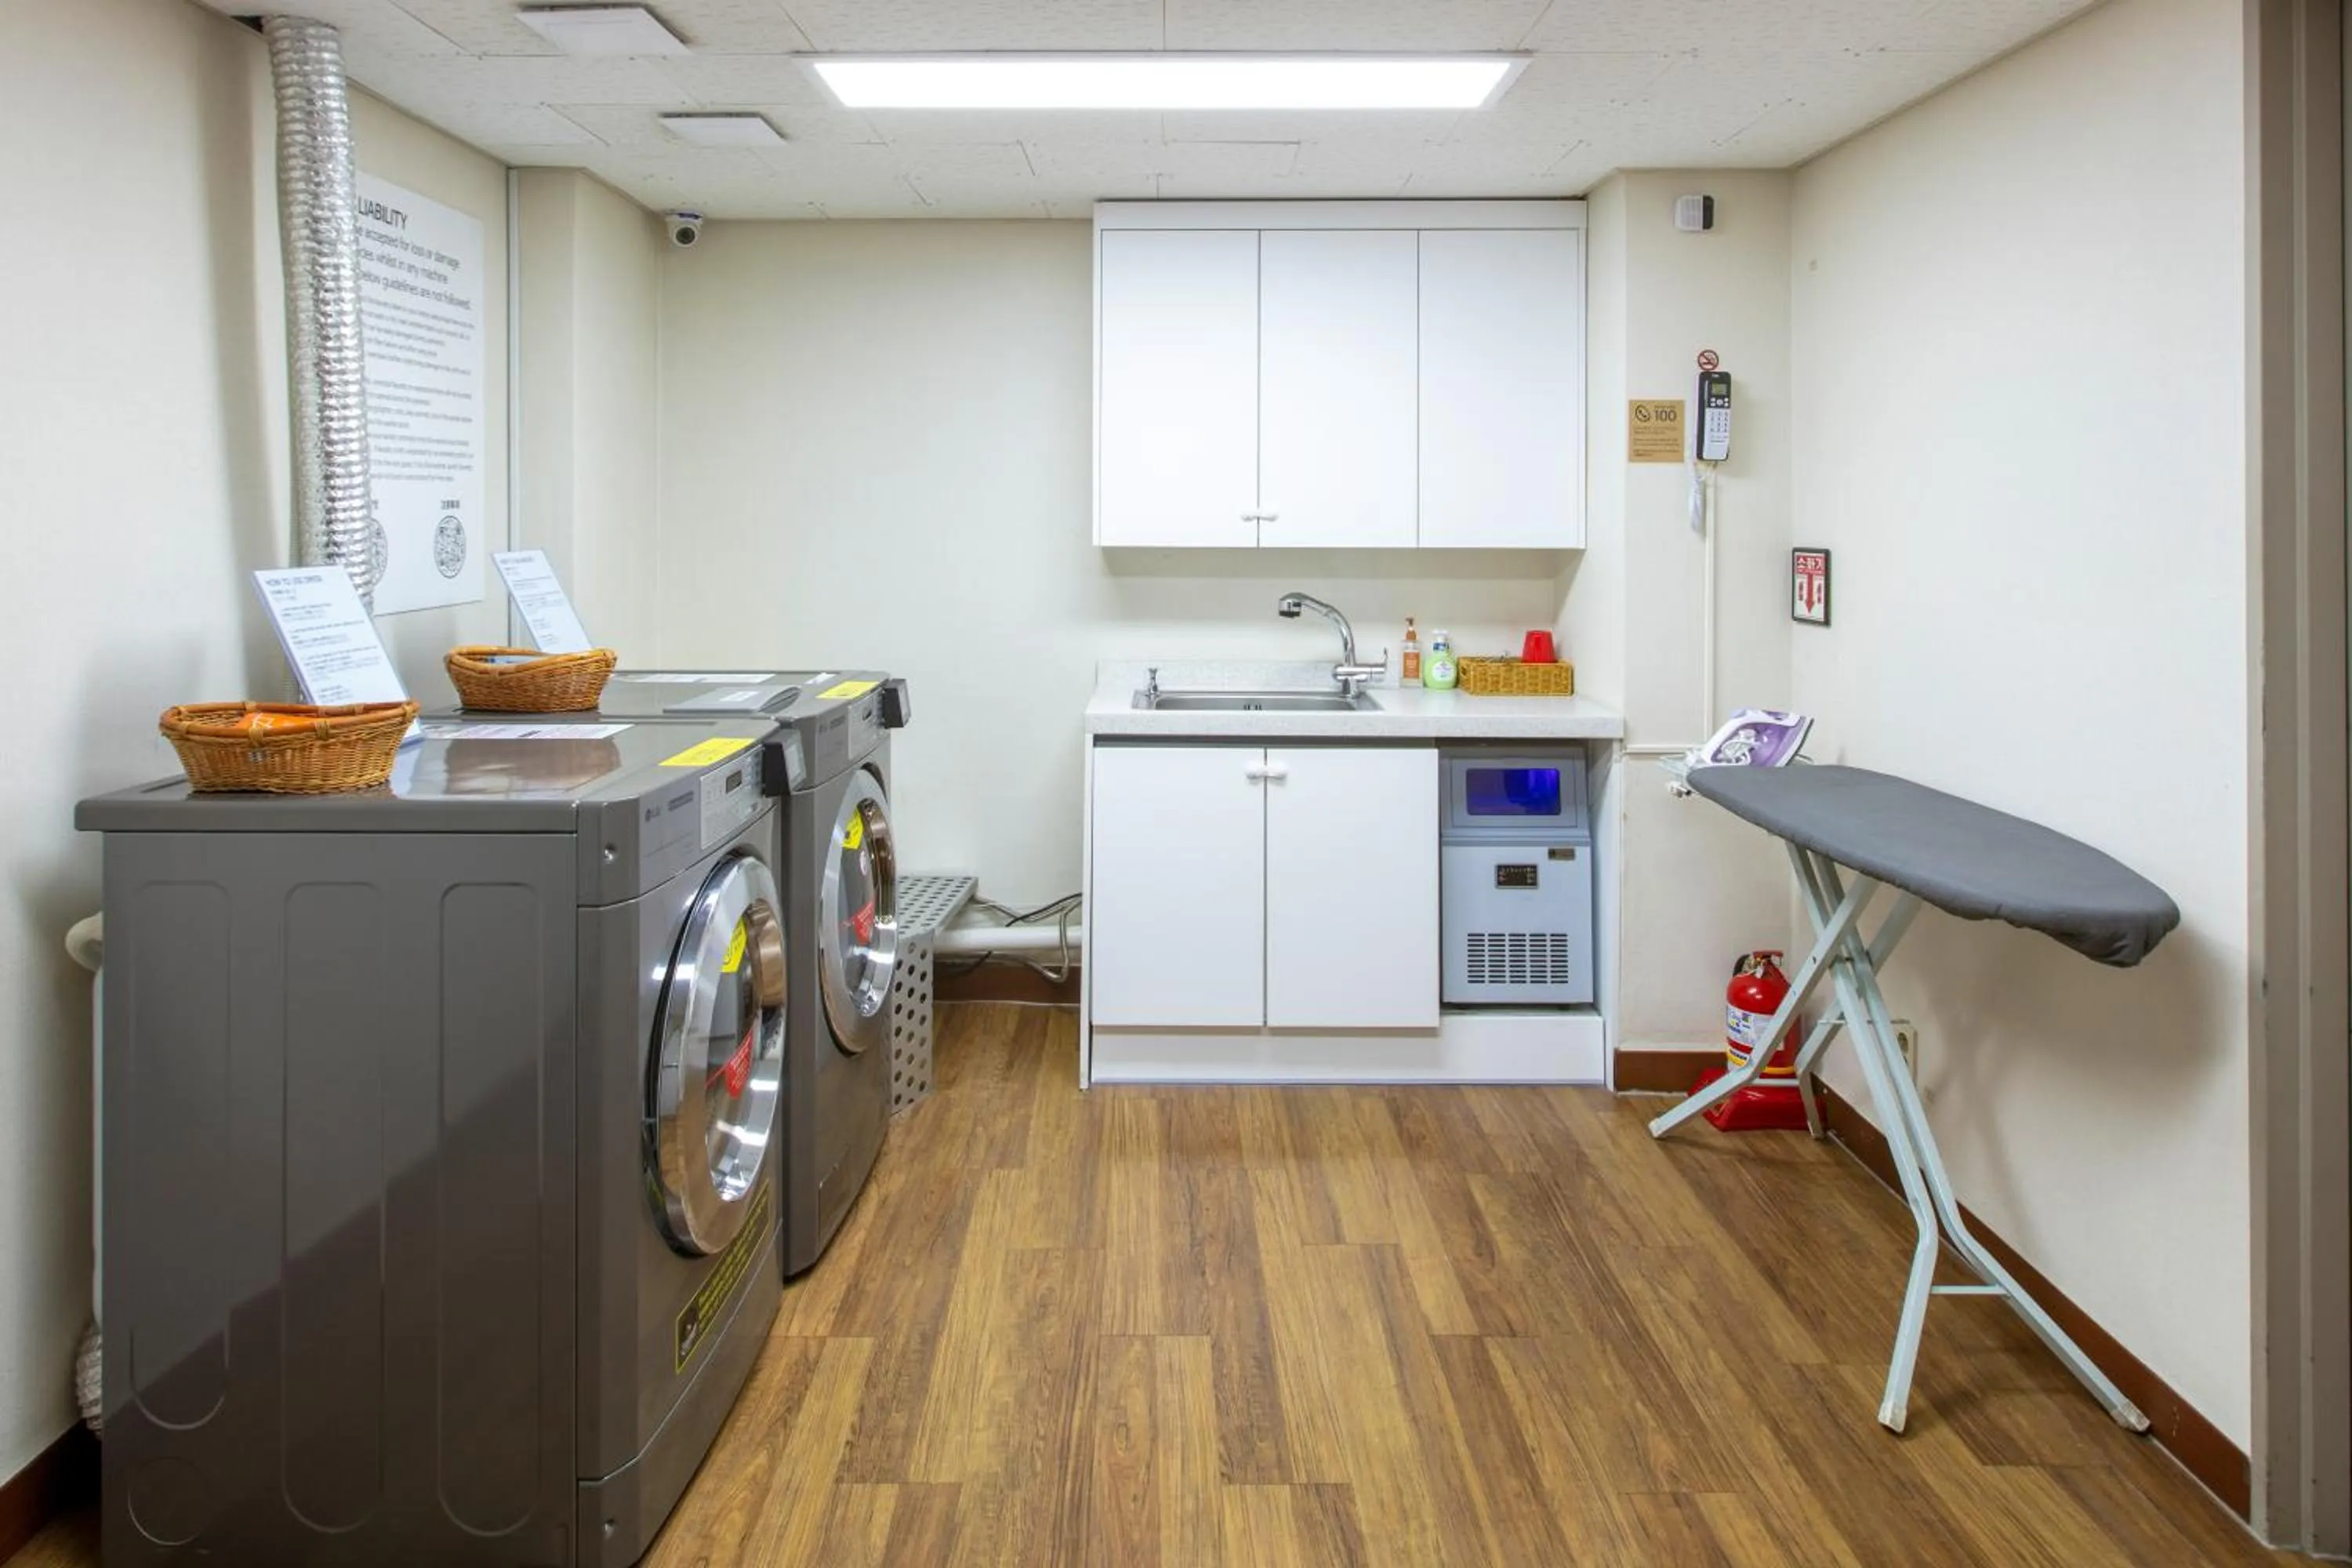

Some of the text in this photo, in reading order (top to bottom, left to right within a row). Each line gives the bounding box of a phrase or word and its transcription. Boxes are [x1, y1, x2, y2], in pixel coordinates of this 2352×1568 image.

[358, 195, 408, 230] LIABILITY
[382, 277, 419, 296] guidelines
[419, 287, 430, 299] are
[1655, 409, 1677, 422] 100
